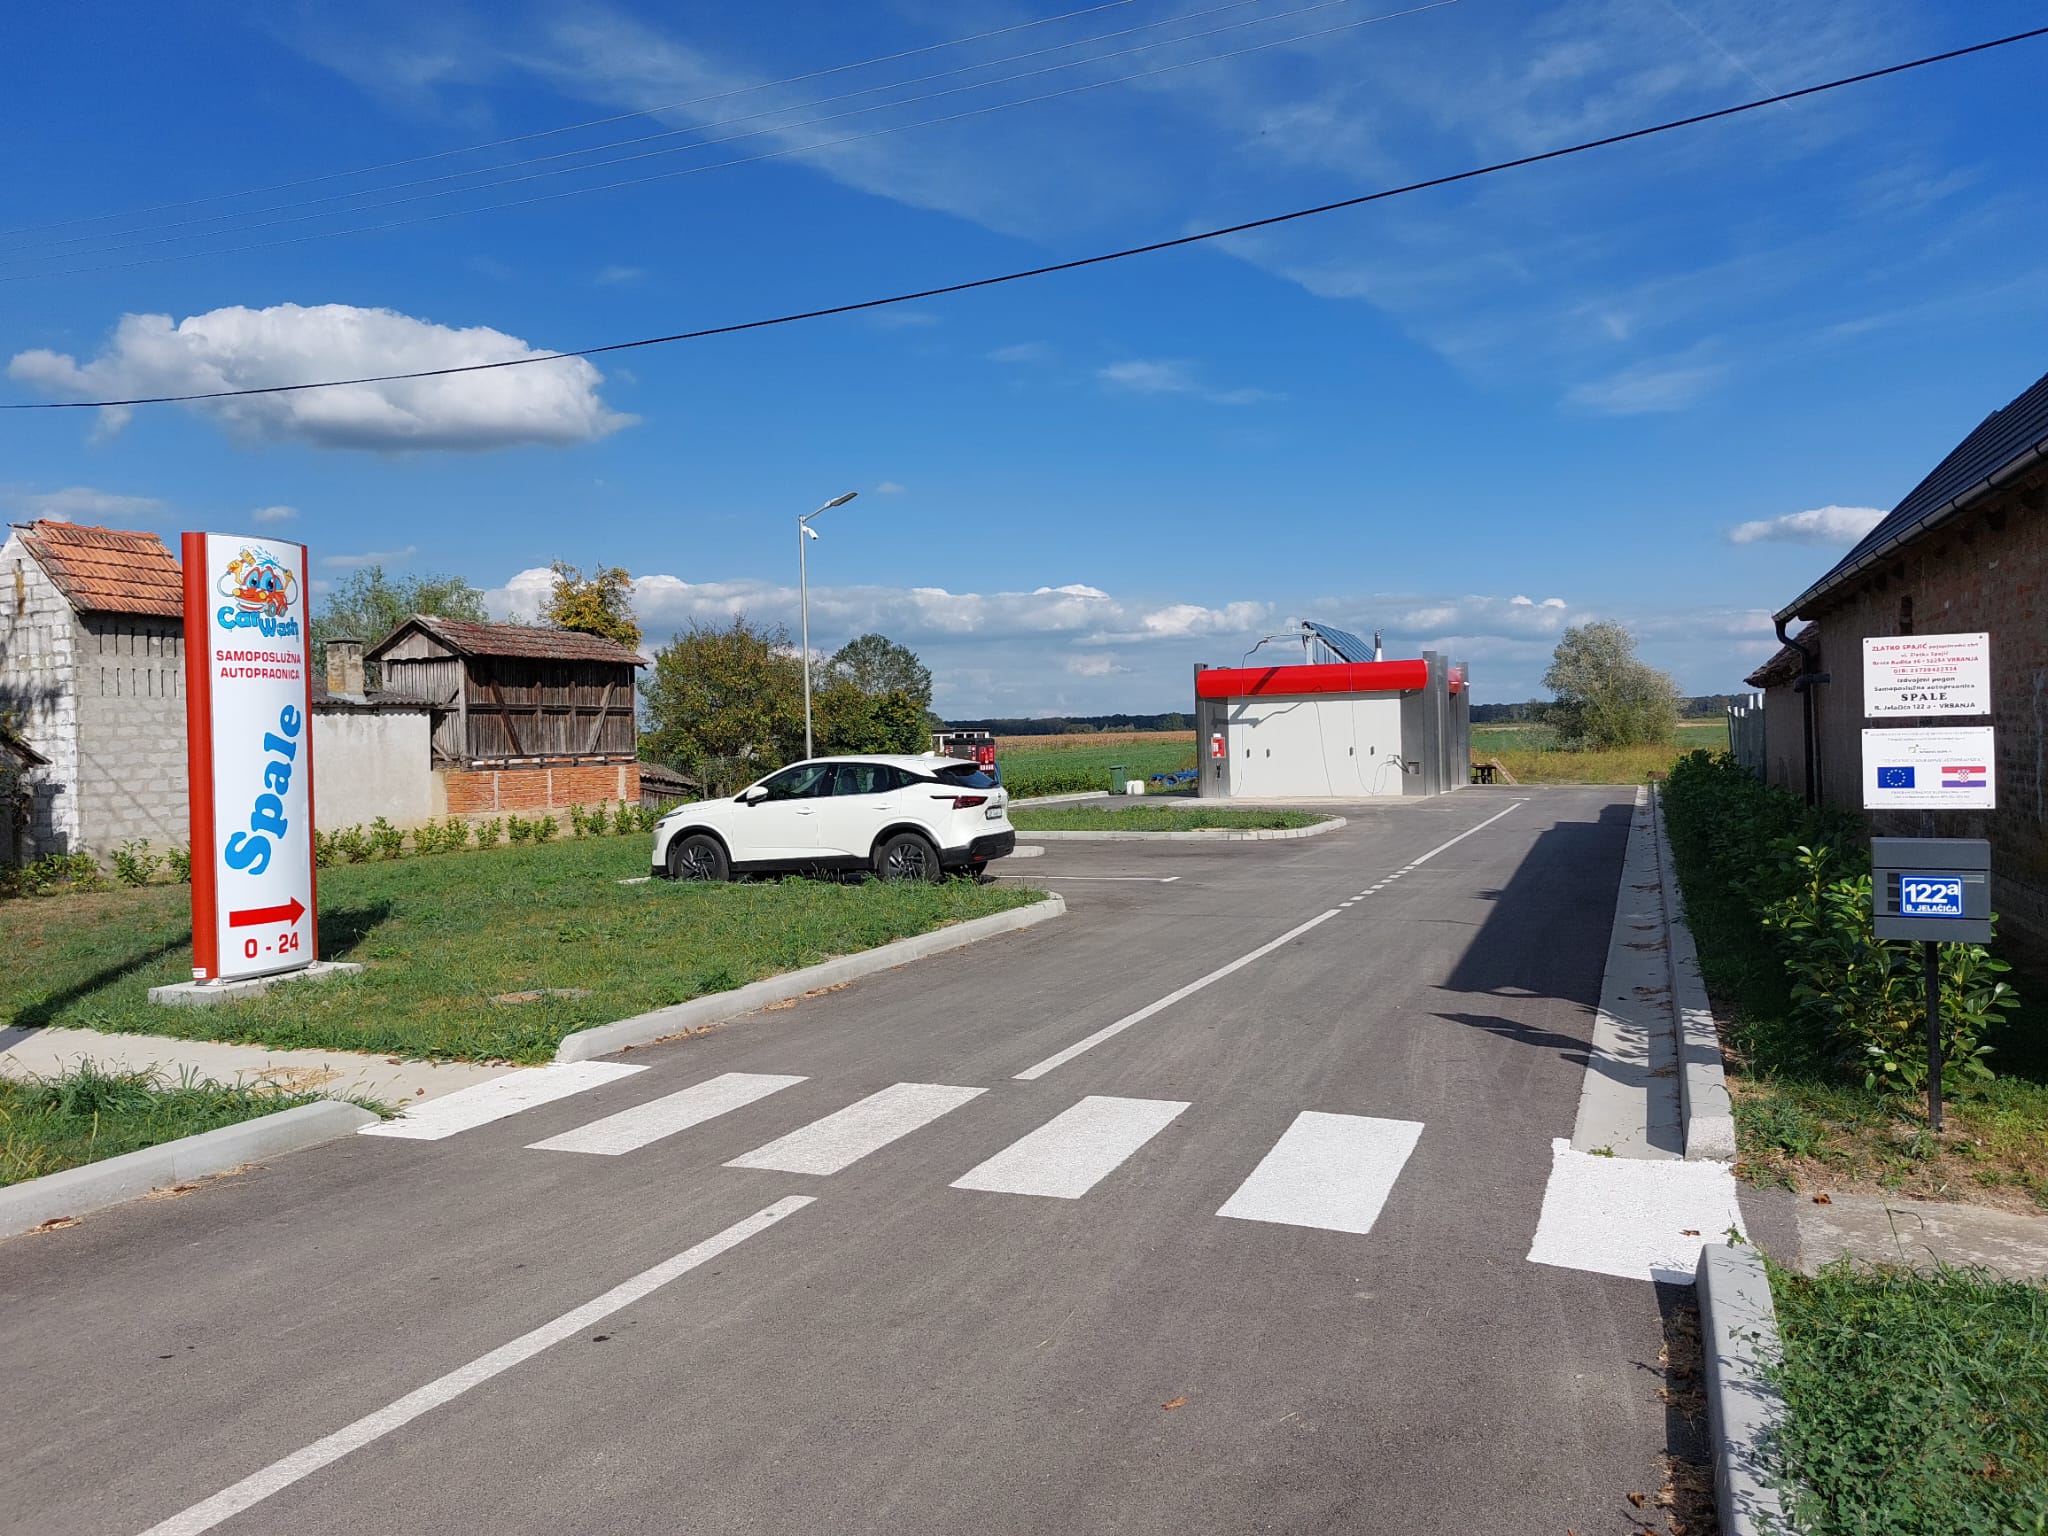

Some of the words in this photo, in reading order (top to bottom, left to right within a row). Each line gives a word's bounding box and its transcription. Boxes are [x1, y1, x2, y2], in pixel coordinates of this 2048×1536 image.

[217, 606, 260, 630] Car
[258, 617, 299, 639] Wash
[216, 650, 301, 664] SAMOPOSLUŽNA
[220, 667, 300, 680] AUTOPRAONICA
[1900, 692, 1948, 701] SPALE
[224, 704, 302, 875] Spale
[1905, 883, 1960, 904] 122a
[1917, 904, 1958, 912] JELAČIĆA
[278, 931, 300, 953] 24
